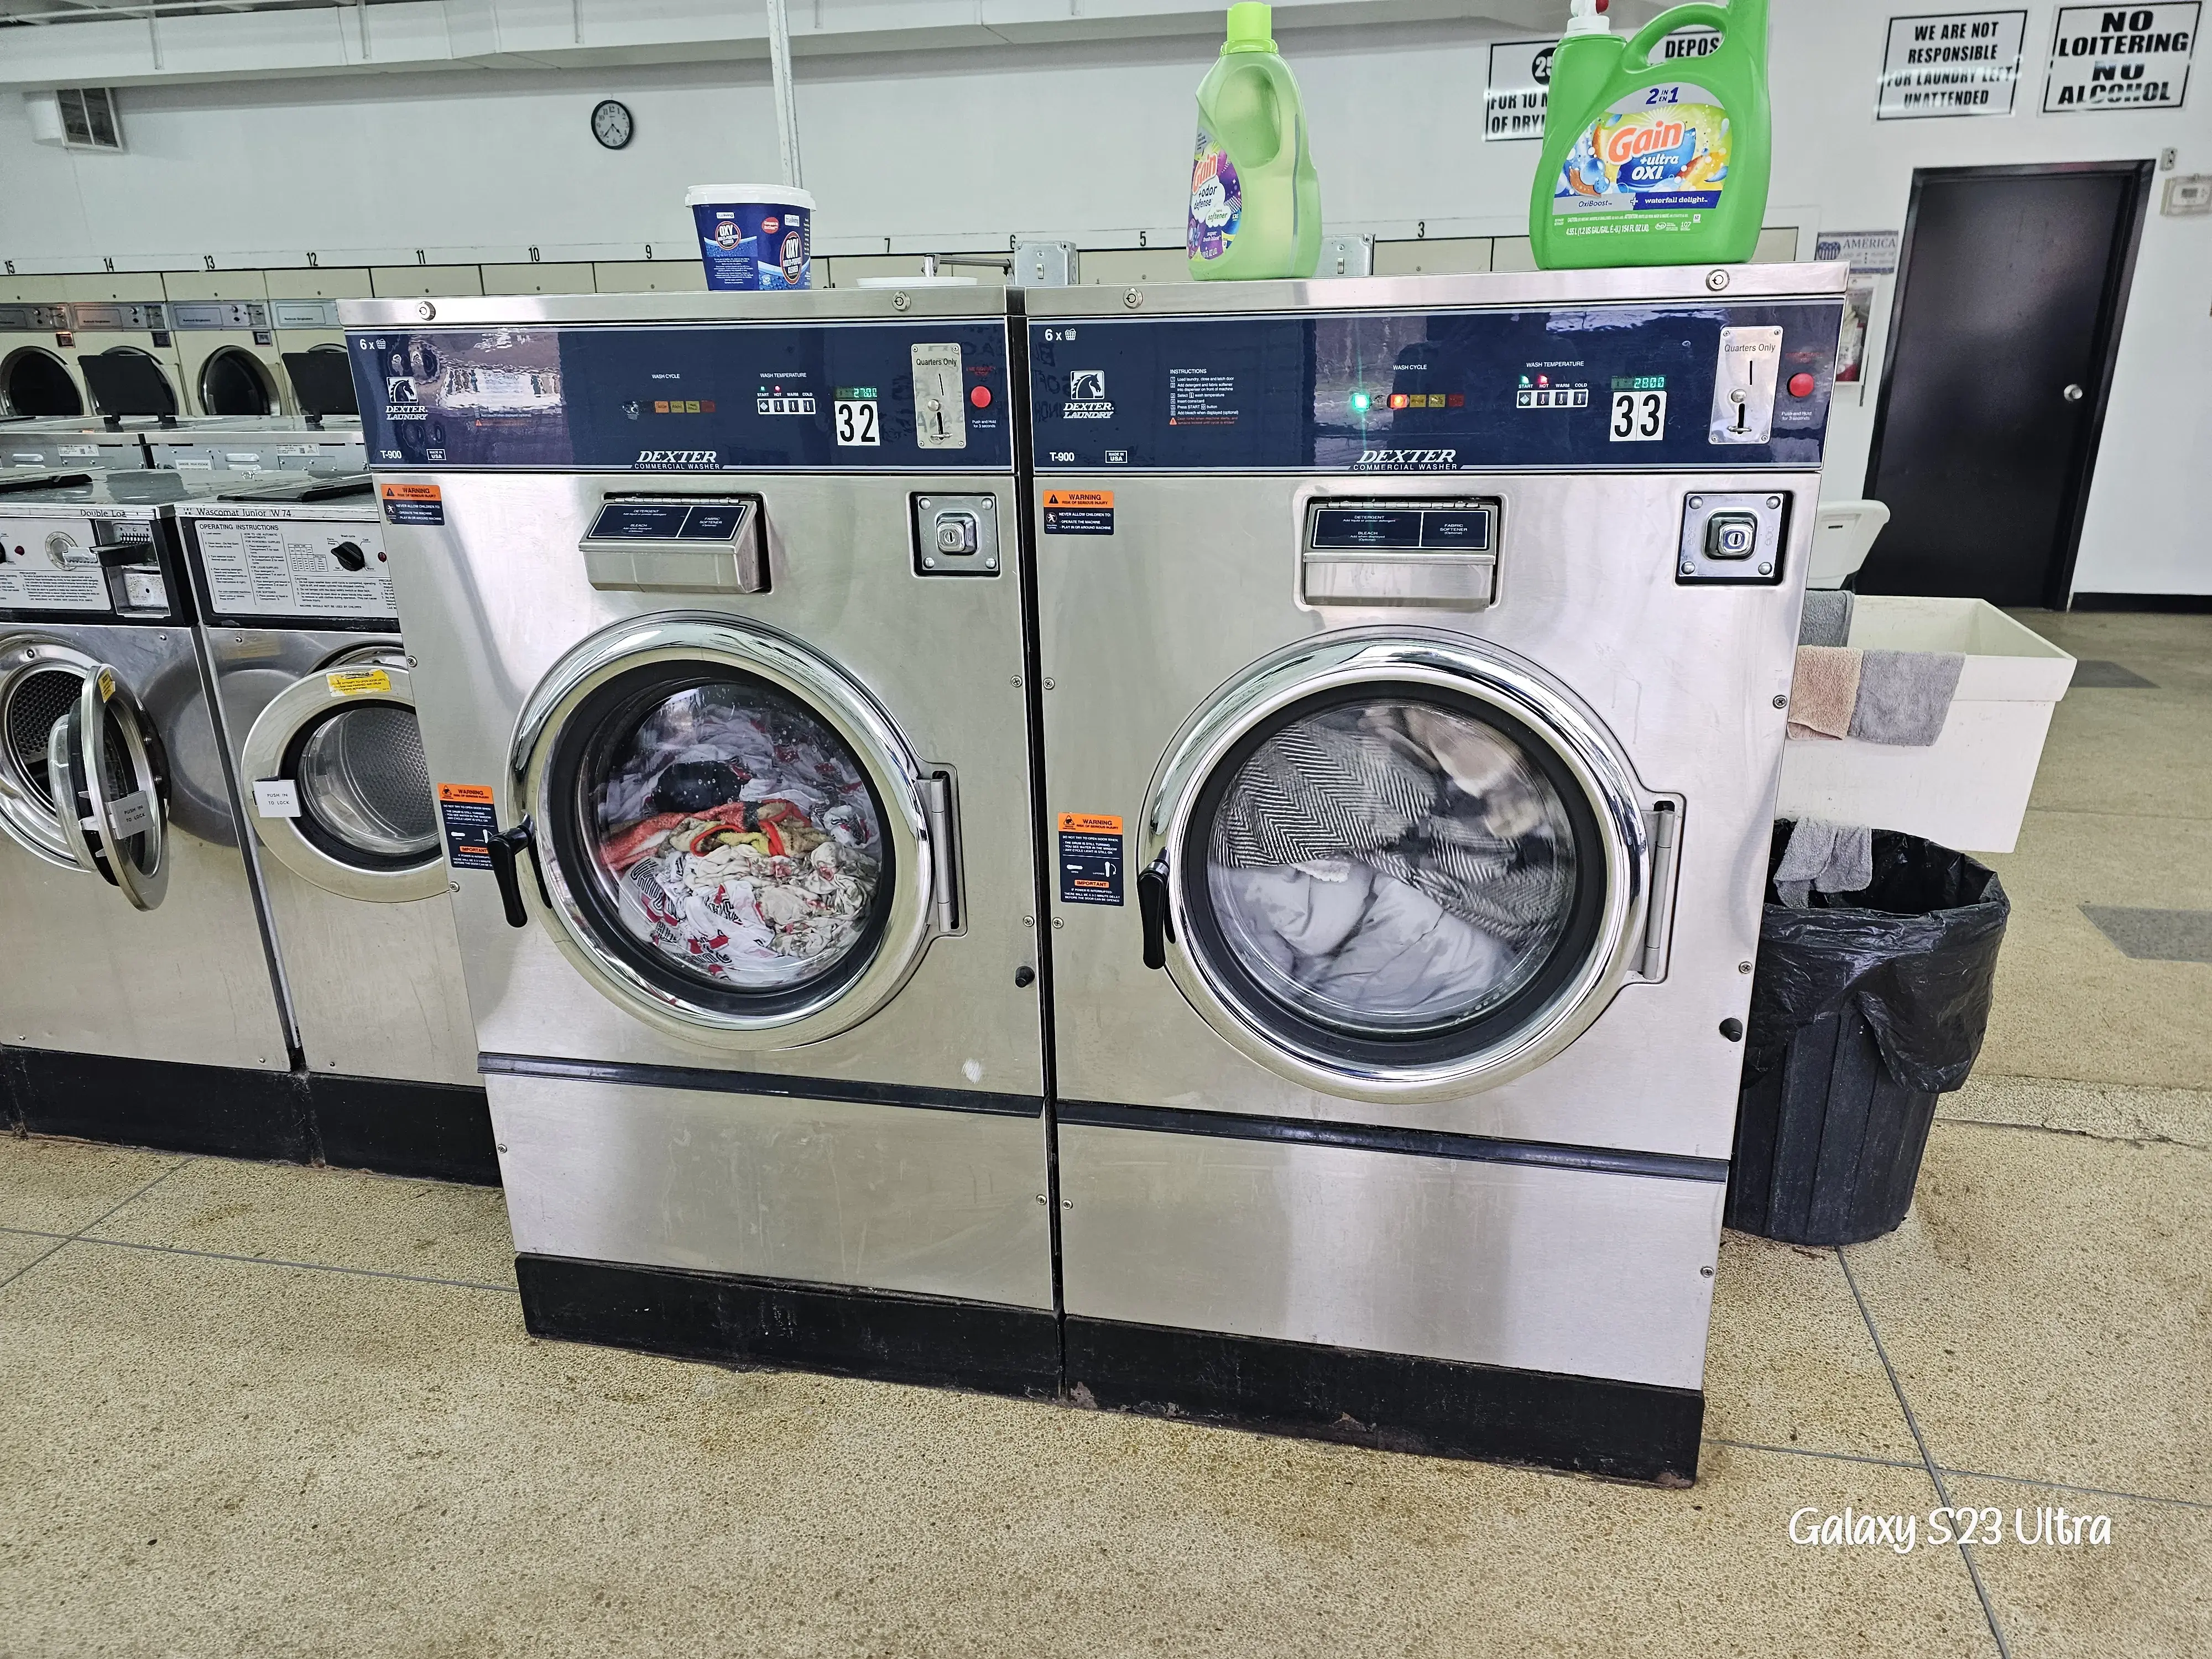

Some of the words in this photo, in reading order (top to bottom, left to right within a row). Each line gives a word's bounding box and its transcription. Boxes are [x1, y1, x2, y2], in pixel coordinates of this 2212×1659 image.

[2101, 9, 2153, 33] NO
[1914, 25, 1935, 41] WE
[1940, 23, 1966, 39] ARE
[1971, 22, 1999, 38] NOT
[2058, 32, 2189, 57] LOITERING
[1908, 45, 1997, 64] RESPONSIBLE
[1917, 69, 1979, 86] LAUNDRY
[1983, 66, 2013, 82] LEFT
[2092, 60, 2145, 81] NO
[1645, 88, 1659, 105] 2
[1668, 87, 1679, 103] 1
[1905, 90, 1989, 109] UNATTENDED
[2058, 81, 2170, 105] ALCOHOL
[1492, 116, 1507, 133] OF
[1608, 120, 1683, 163] Gain
[1193, 154, 1217, 192] Gain
[1194, 199, 1212, 210] defense
[1208, 212, 1227, 222] softener
[719, 225, 733, 237] OXY
[1417, 222, 1425, 238] 3
[885, 238, 890, 253] 7
[1010, 234, 1016, 249] 6
[1139, 231, 1146, 247] 5
[1843, 238, 1895, 249] AMERICA
[529, 247, 540, 262] 10
[646, 245, 653, 259] 9
[786, 238, 798, 259] OXY
[204, 255, 215, 269] 13
[306, 252, 319, 267] 12
[416, 250, 426, 264] 11
[4, 260, 15, 275] 15
[104, 258, 114, 272] 14
[1045, 328, 1052, 341] 6
[360, 338, 367, 349] 6
[1759, 344, 1776, 352] Only
[943, 358, 957, 367] Only
[839, 404, 875, 442] 32
[1614, 394, 1660, 437] 33
[380, 450, 402, 459] T-900
[637, 451, 717, 463] DEXTER
[1050, 452, 1074, 461] T-900
[1357, 450, 1456, 463] DEXTER
[196, 508, 239, 516] Wascomat
[242, 508, 266, 517] Junior
